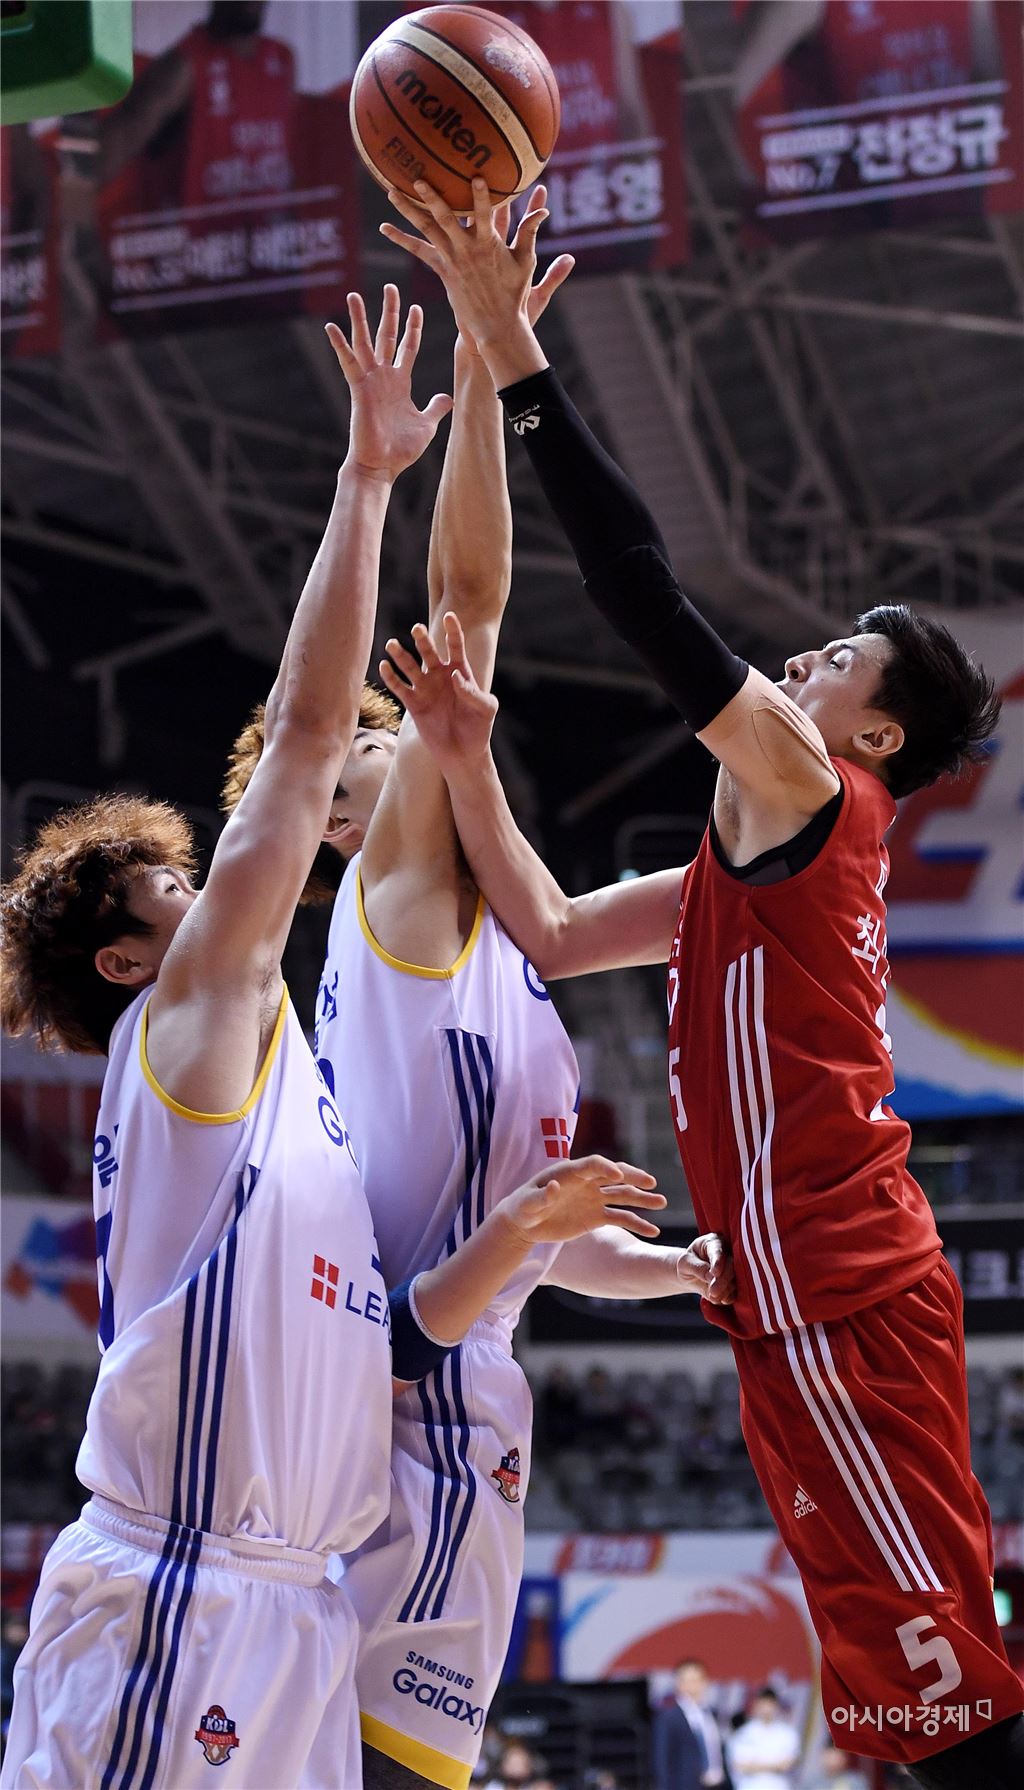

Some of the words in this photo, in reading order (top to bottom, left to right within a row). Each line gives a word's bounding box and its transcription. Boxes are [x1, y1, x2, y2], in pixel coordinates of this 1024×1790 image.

[394, 69, 492, 169] molten
[405, 1650, 475, 1690] SAMSUNG
[895, 1614, 963, 1707] 5
